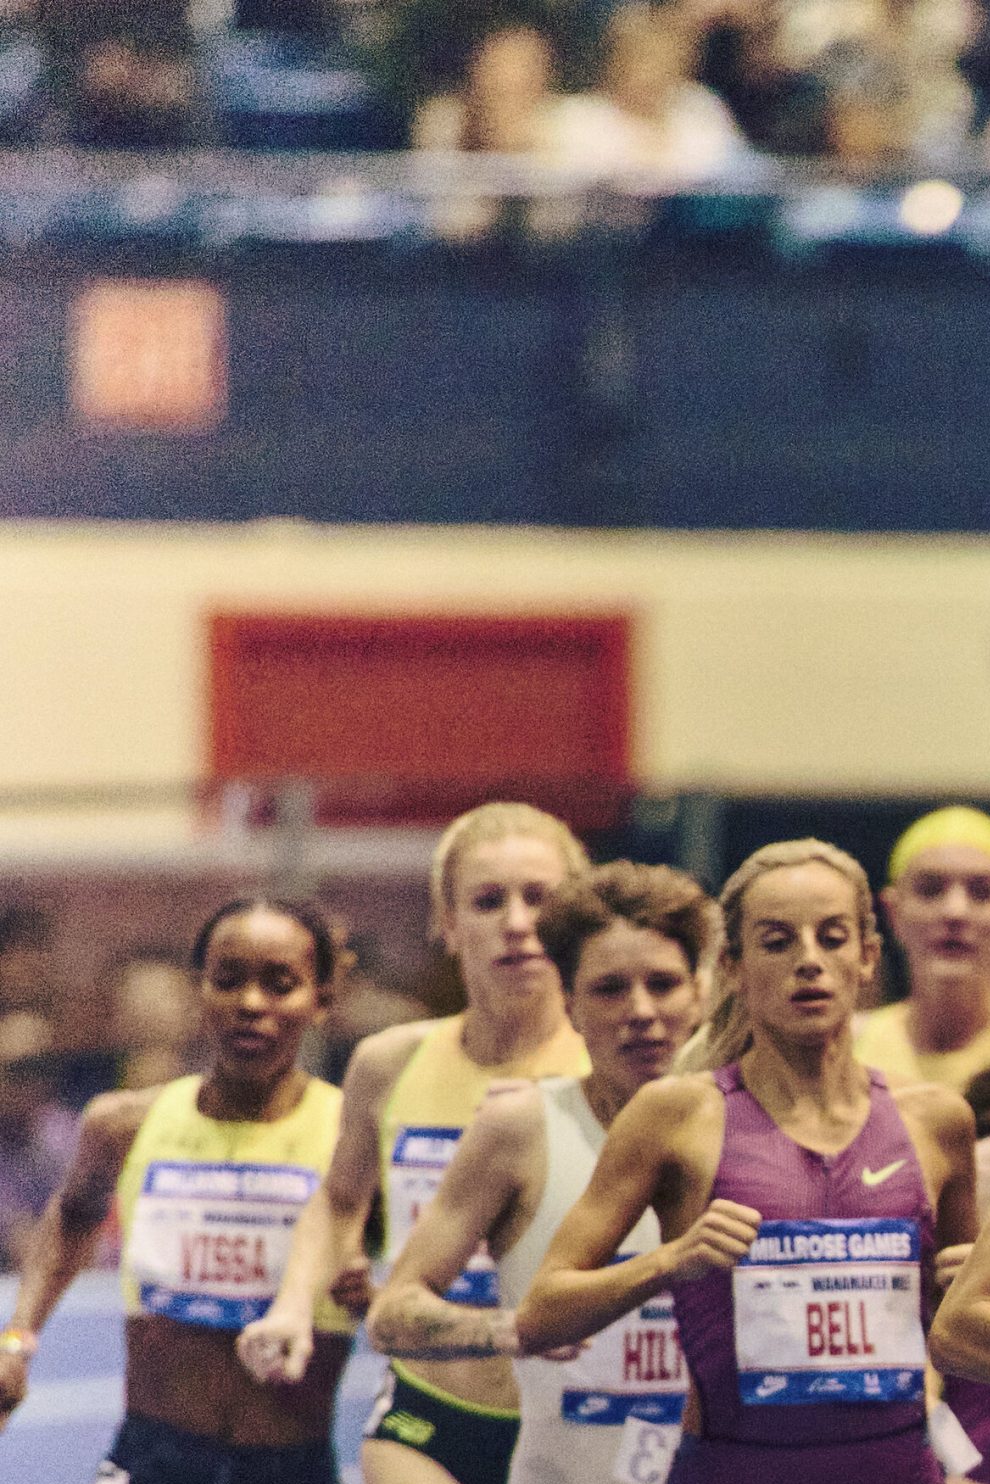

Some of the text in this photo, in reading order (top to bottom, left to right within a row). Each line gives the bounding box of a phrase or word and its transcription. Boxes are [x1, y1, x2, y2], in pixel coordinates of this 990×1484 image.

[751, 1232, 911, 1262] MILLROSE GAMES
[806, 1301, 875, 1357] BELL
